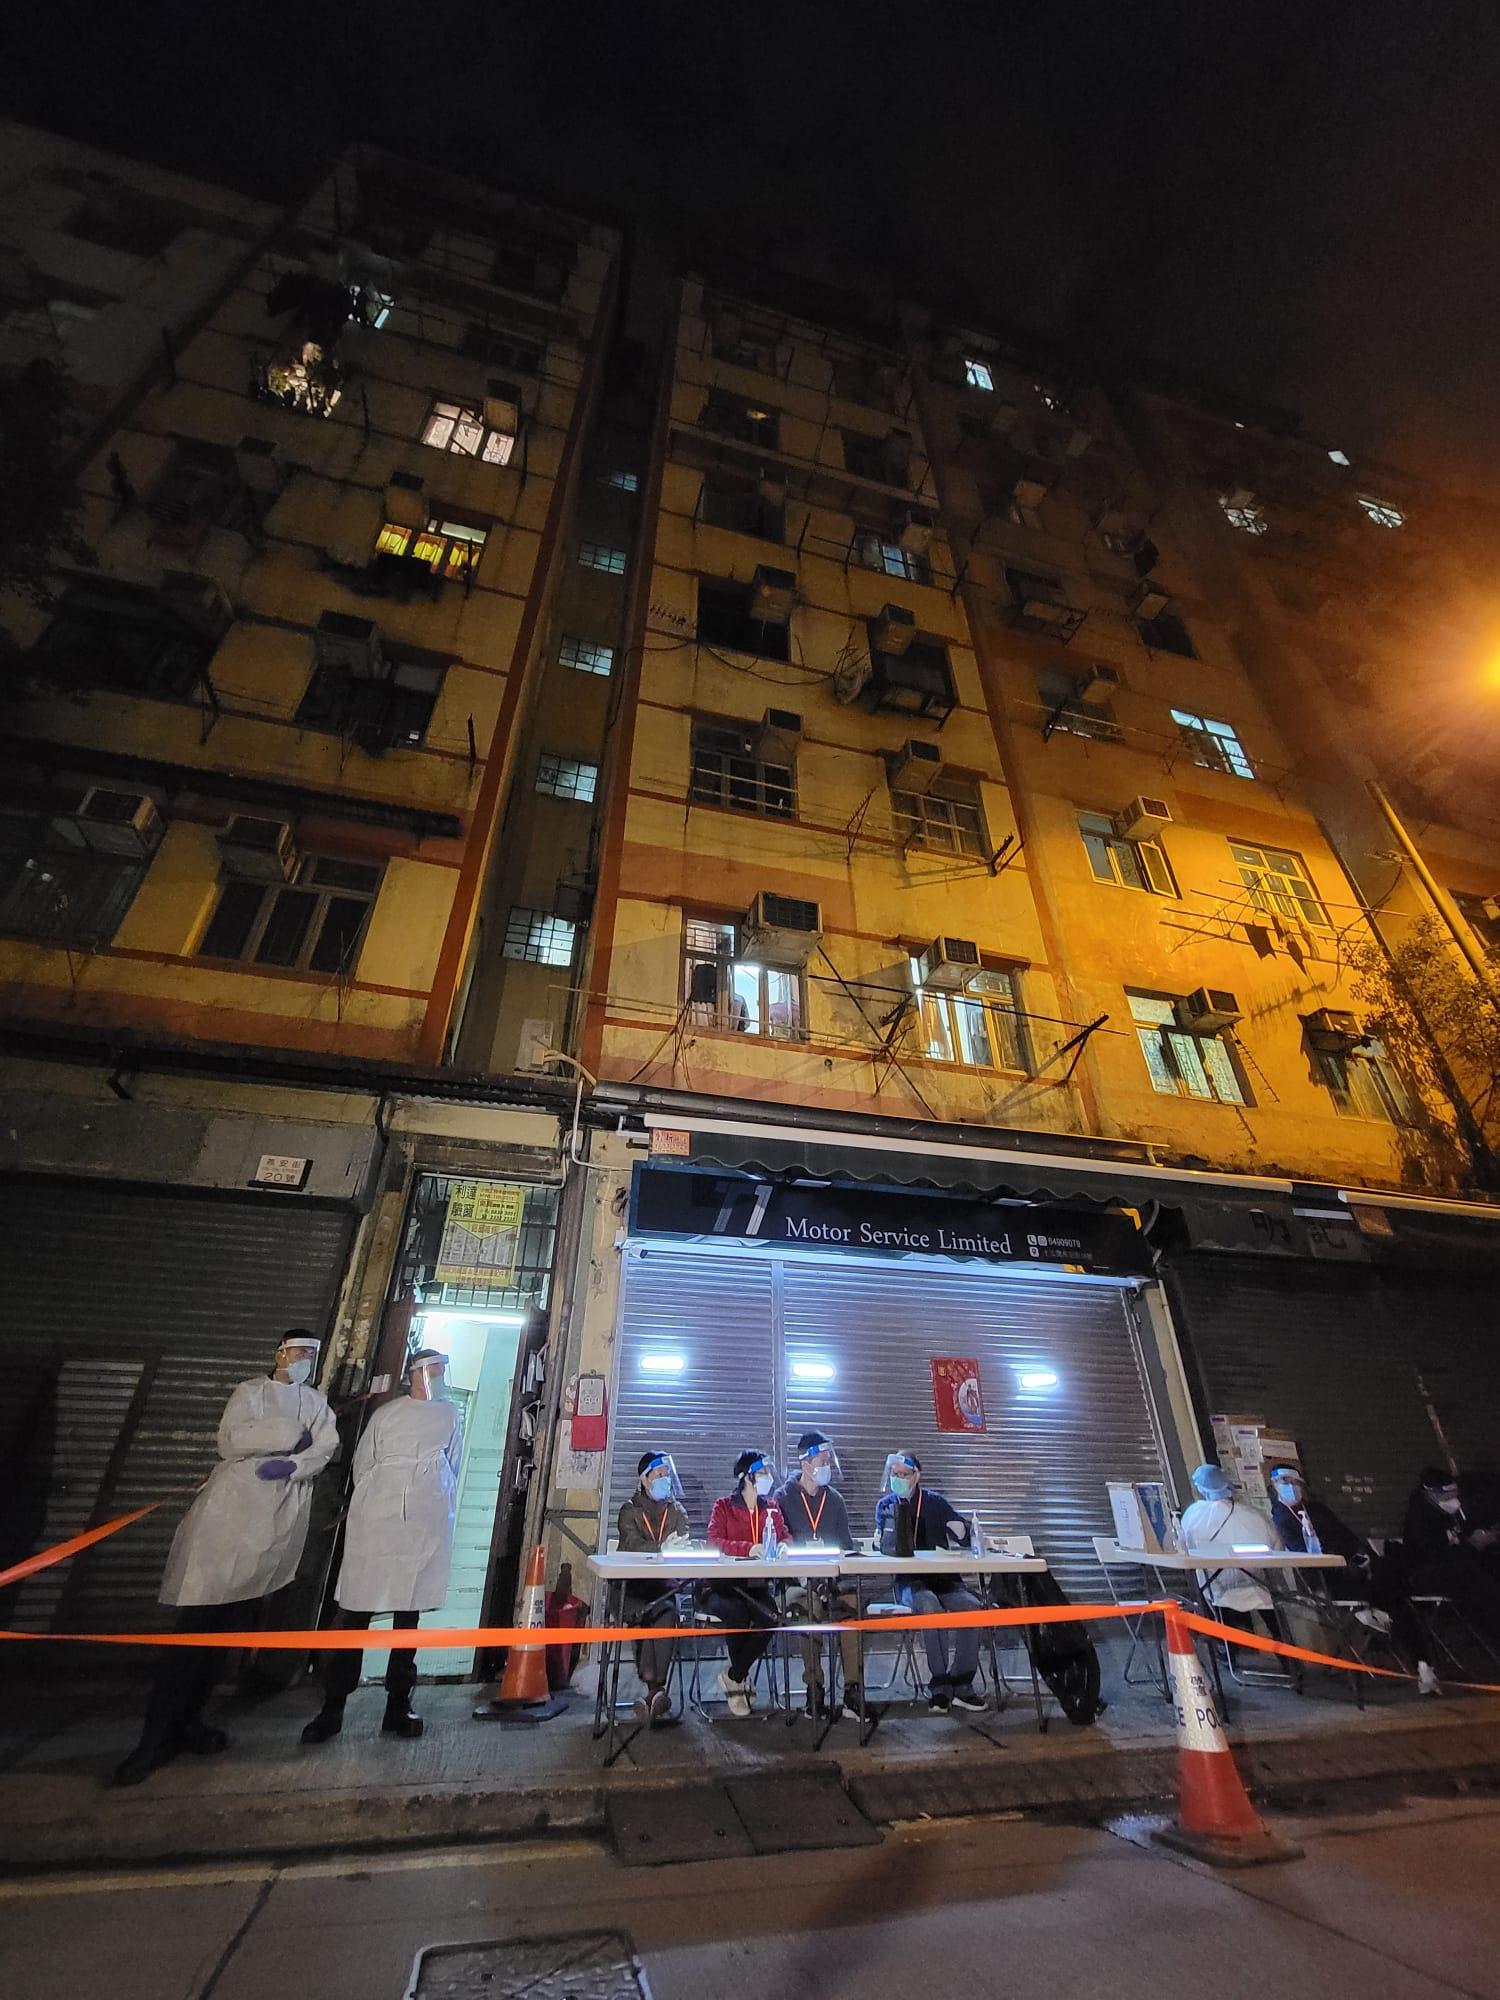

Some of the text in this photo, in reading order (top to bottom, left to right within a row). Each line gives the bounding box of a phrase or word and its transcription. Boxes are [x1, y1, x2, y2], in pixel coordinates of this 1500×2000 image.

[455, 1183, 477, 1200] 利達
[785, 1216, 852, 1242] Motor
[860, 1222, 930, 1248] Service
[936, 1229, 1013, 1255] Limited
